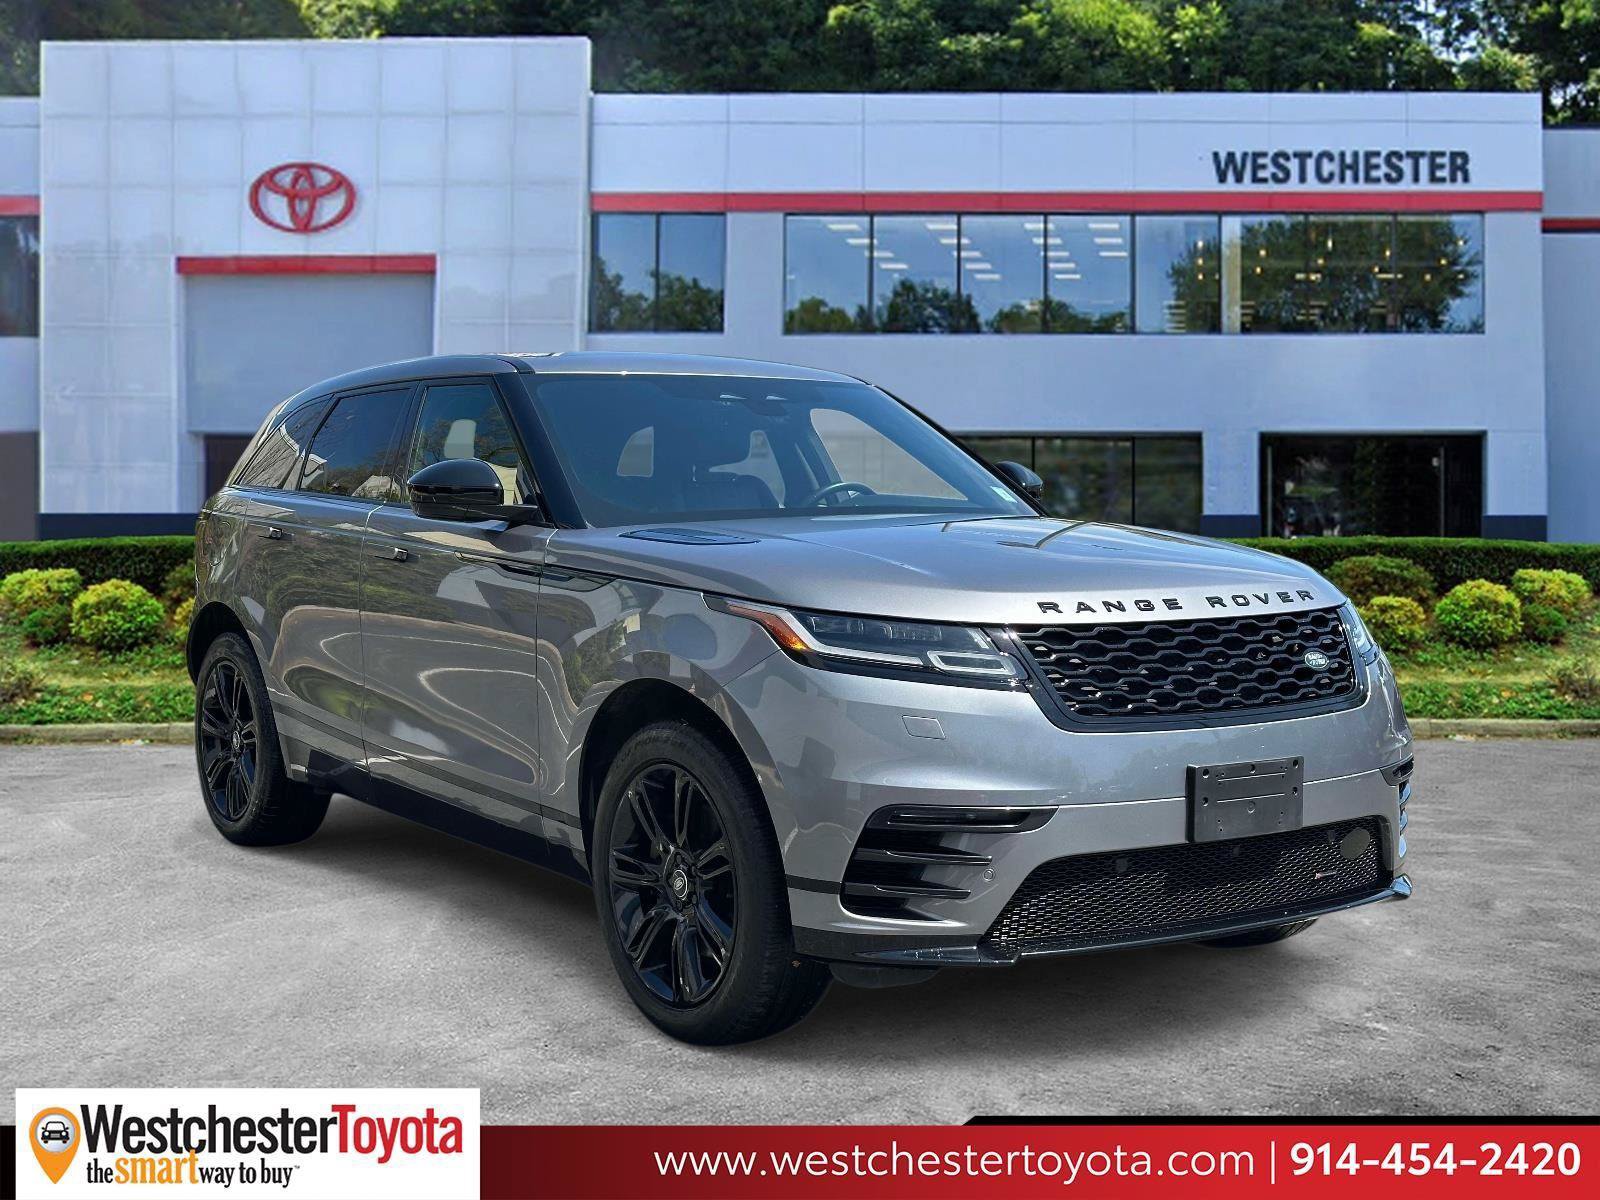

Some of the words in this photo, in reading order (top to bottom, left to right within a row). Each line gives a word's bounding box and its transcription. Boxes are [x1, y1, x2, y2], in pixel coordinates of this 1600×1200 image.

[1212, 150, 1471, 185] WESTCHESTER
[1036, 597, 1183, 614] RANGE
[1205, 589, 1315, 609] ROVER
